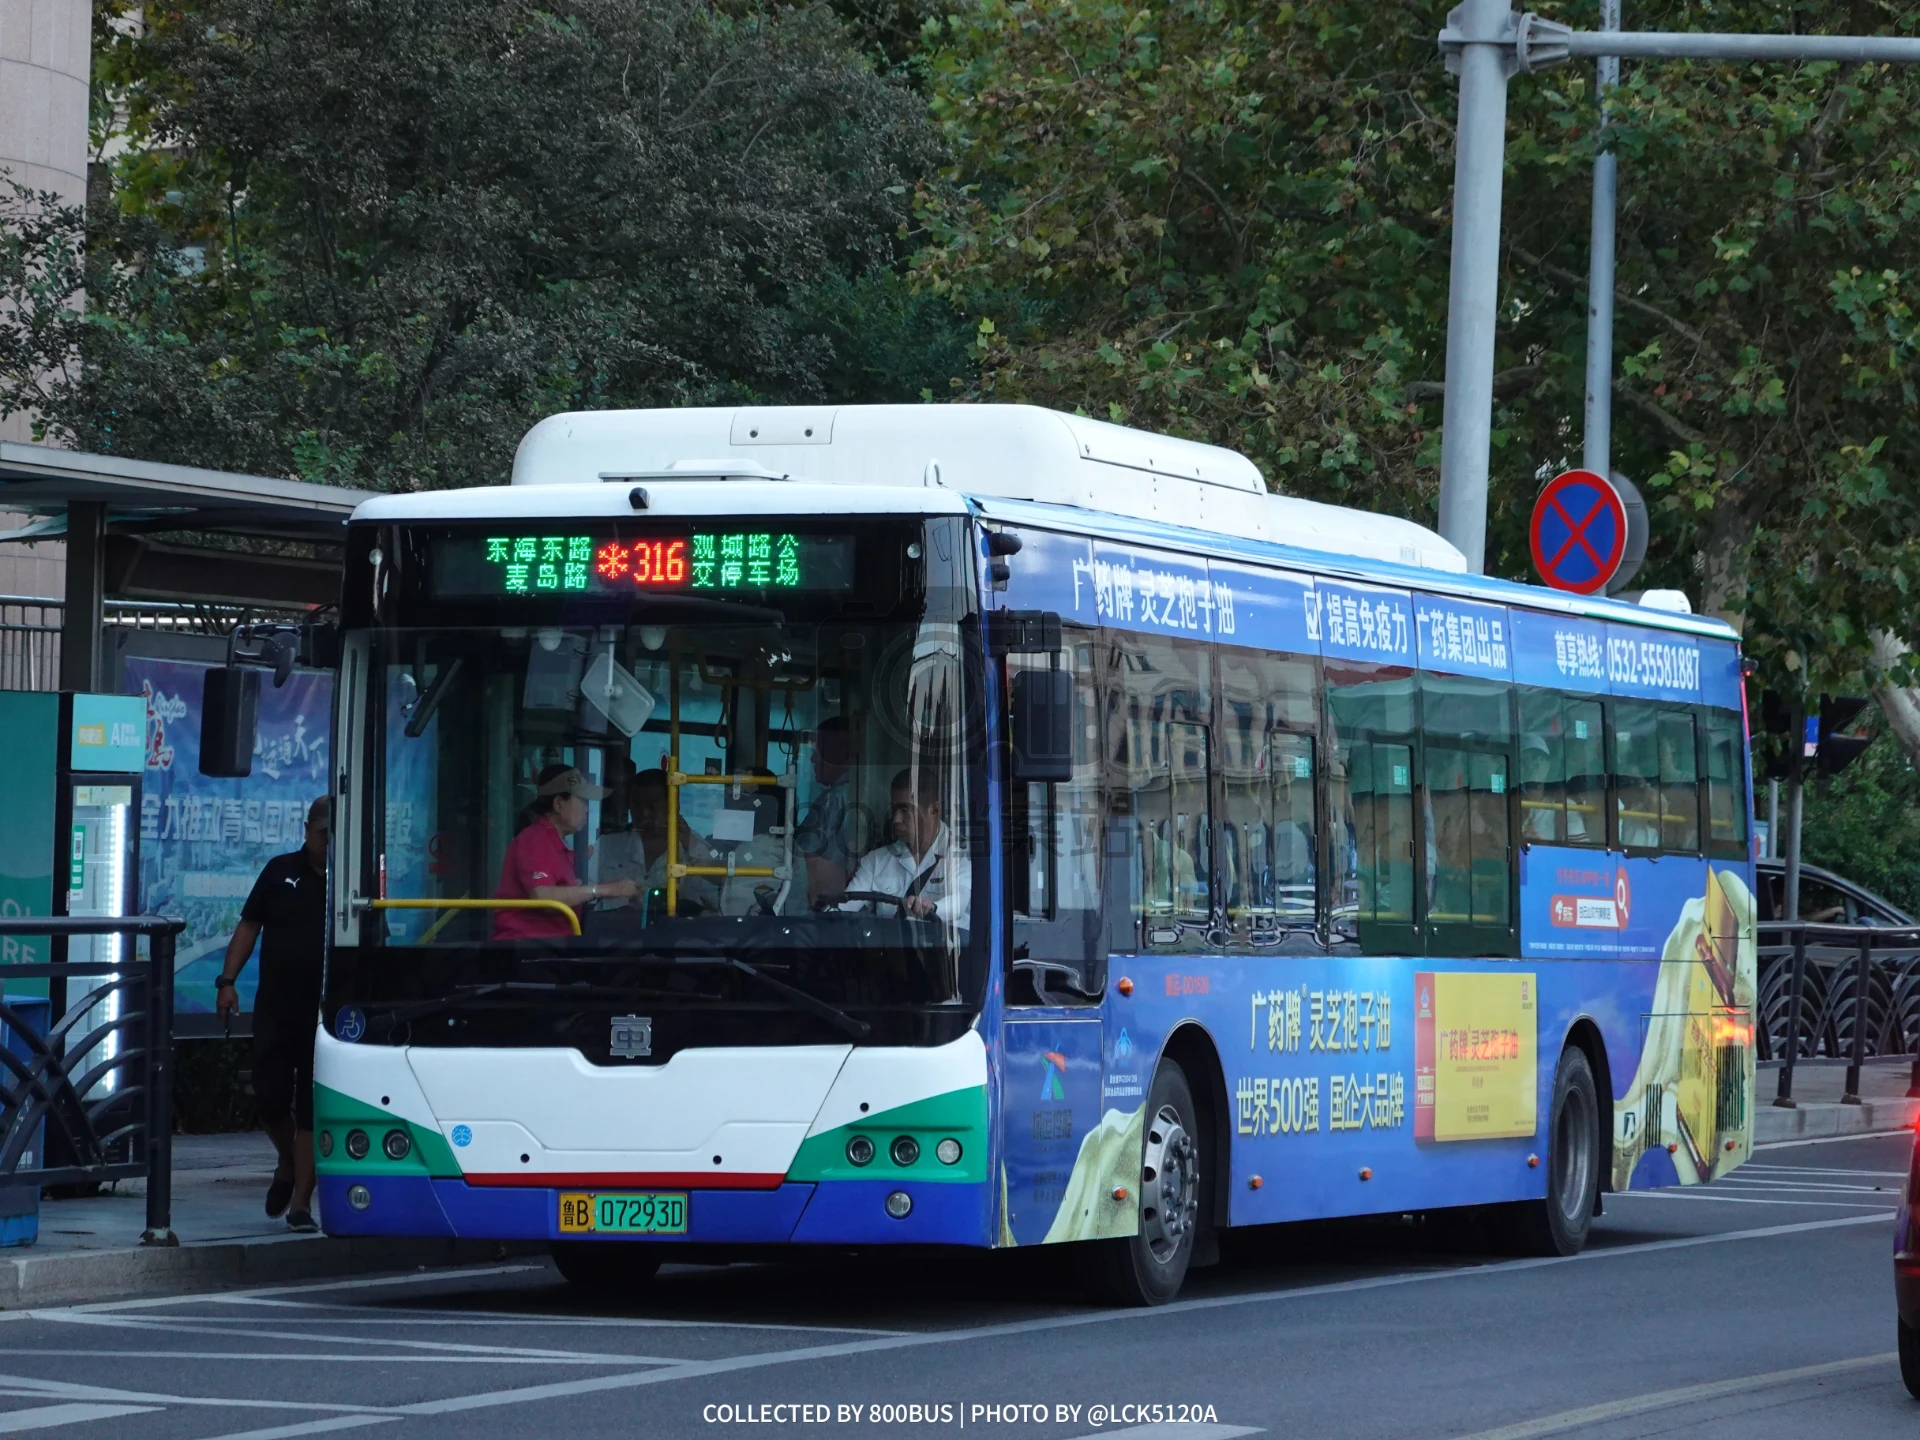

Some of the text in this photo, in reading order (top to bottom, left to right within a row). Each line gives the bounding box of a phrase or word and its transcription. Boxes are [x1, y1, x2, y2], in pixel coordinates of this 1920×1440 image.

[486, 537, 592, 562] 东海东路
[633, 542, 684, 582] 316
[506, 563, 587, 590] 麦岛路
[692, 559, 799, 587] 交停车场
[1327, 591, 1408, 654] 提高免疫力
[1416, 606, 1507, 669] 广药集团出品
[140, 793, 312, 845] 全力推动青岛国际
[1236, 1072, 1404, 1136] 世界500强 国企大品牌
